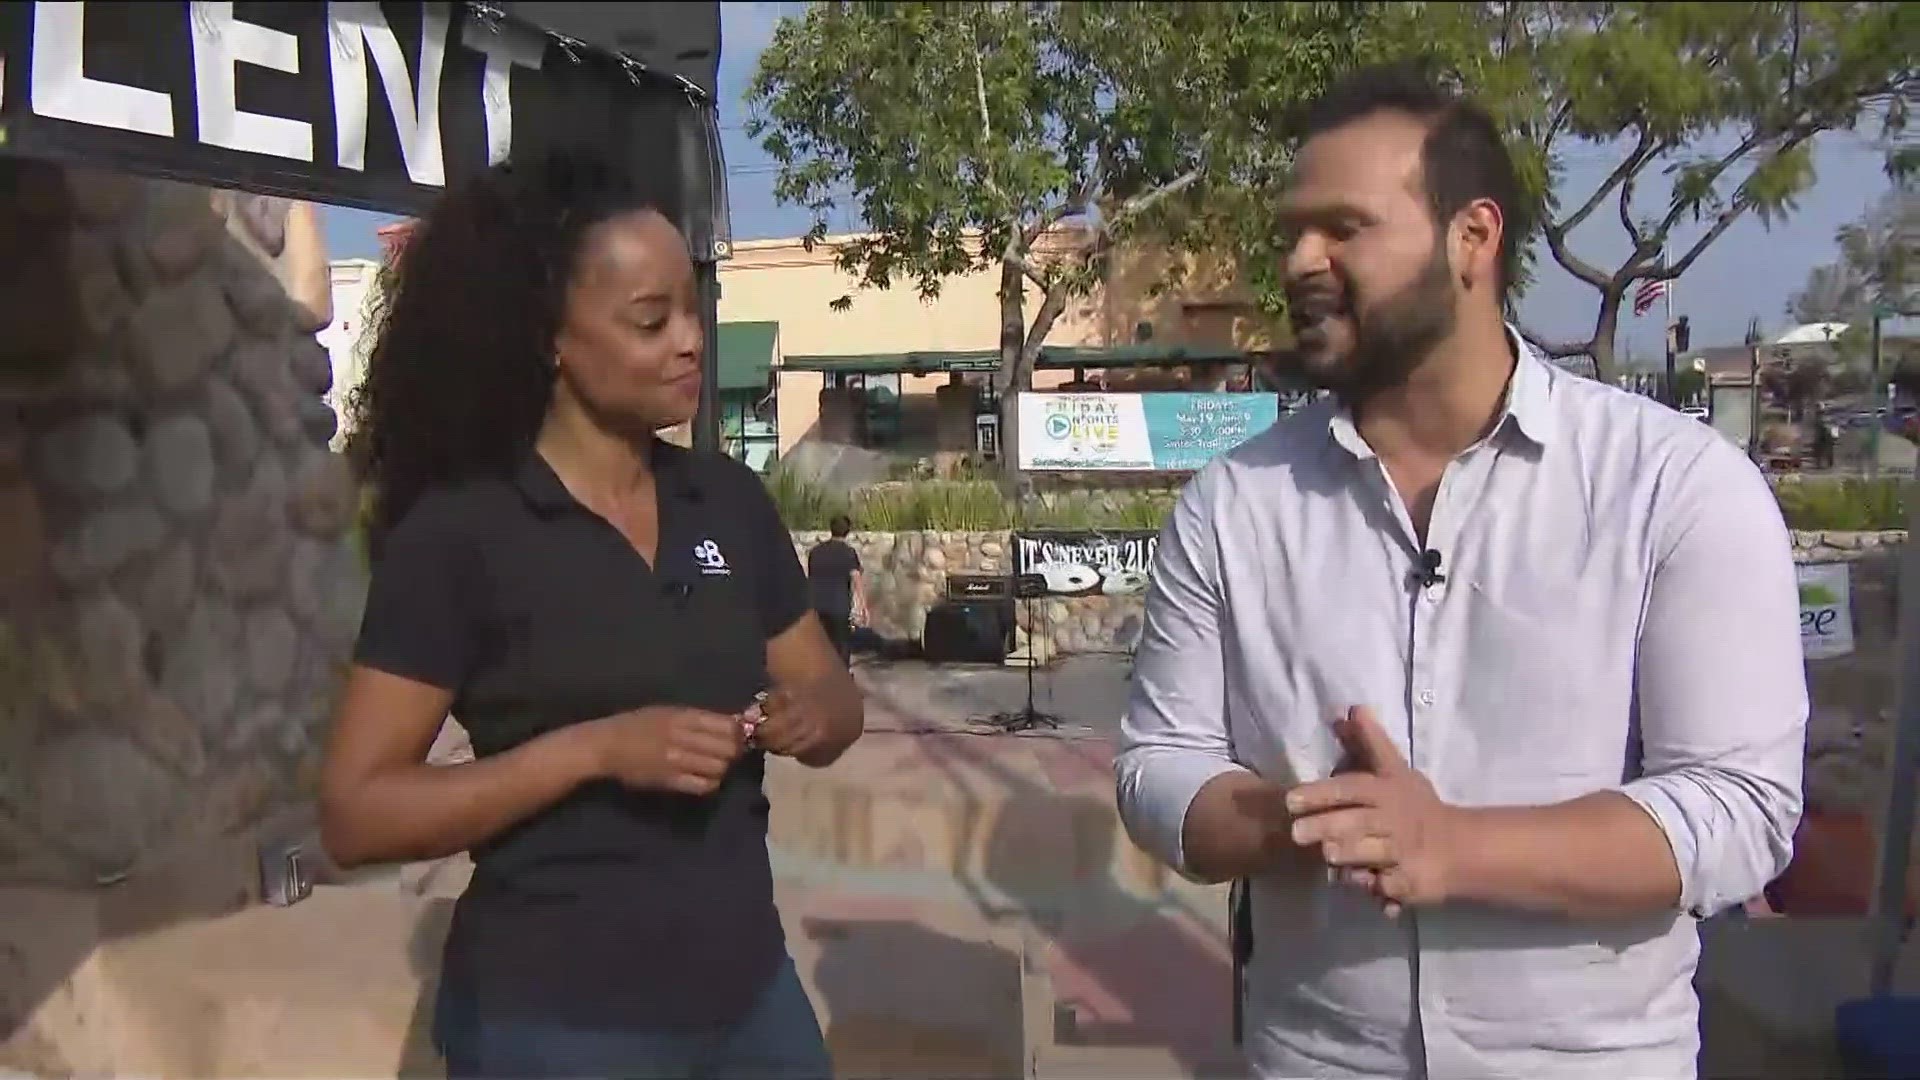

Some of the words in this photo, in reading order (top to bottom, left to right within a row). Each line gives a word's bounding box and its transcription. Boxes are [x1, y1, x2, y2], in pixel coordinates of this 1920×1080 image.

[0, 1, 547, 188] LENT
[1073, 426, 1118, 438] LIVE
[1019, 538, 1054, 575] IT'S
[1057, 544, 1122, 570] NEVER
